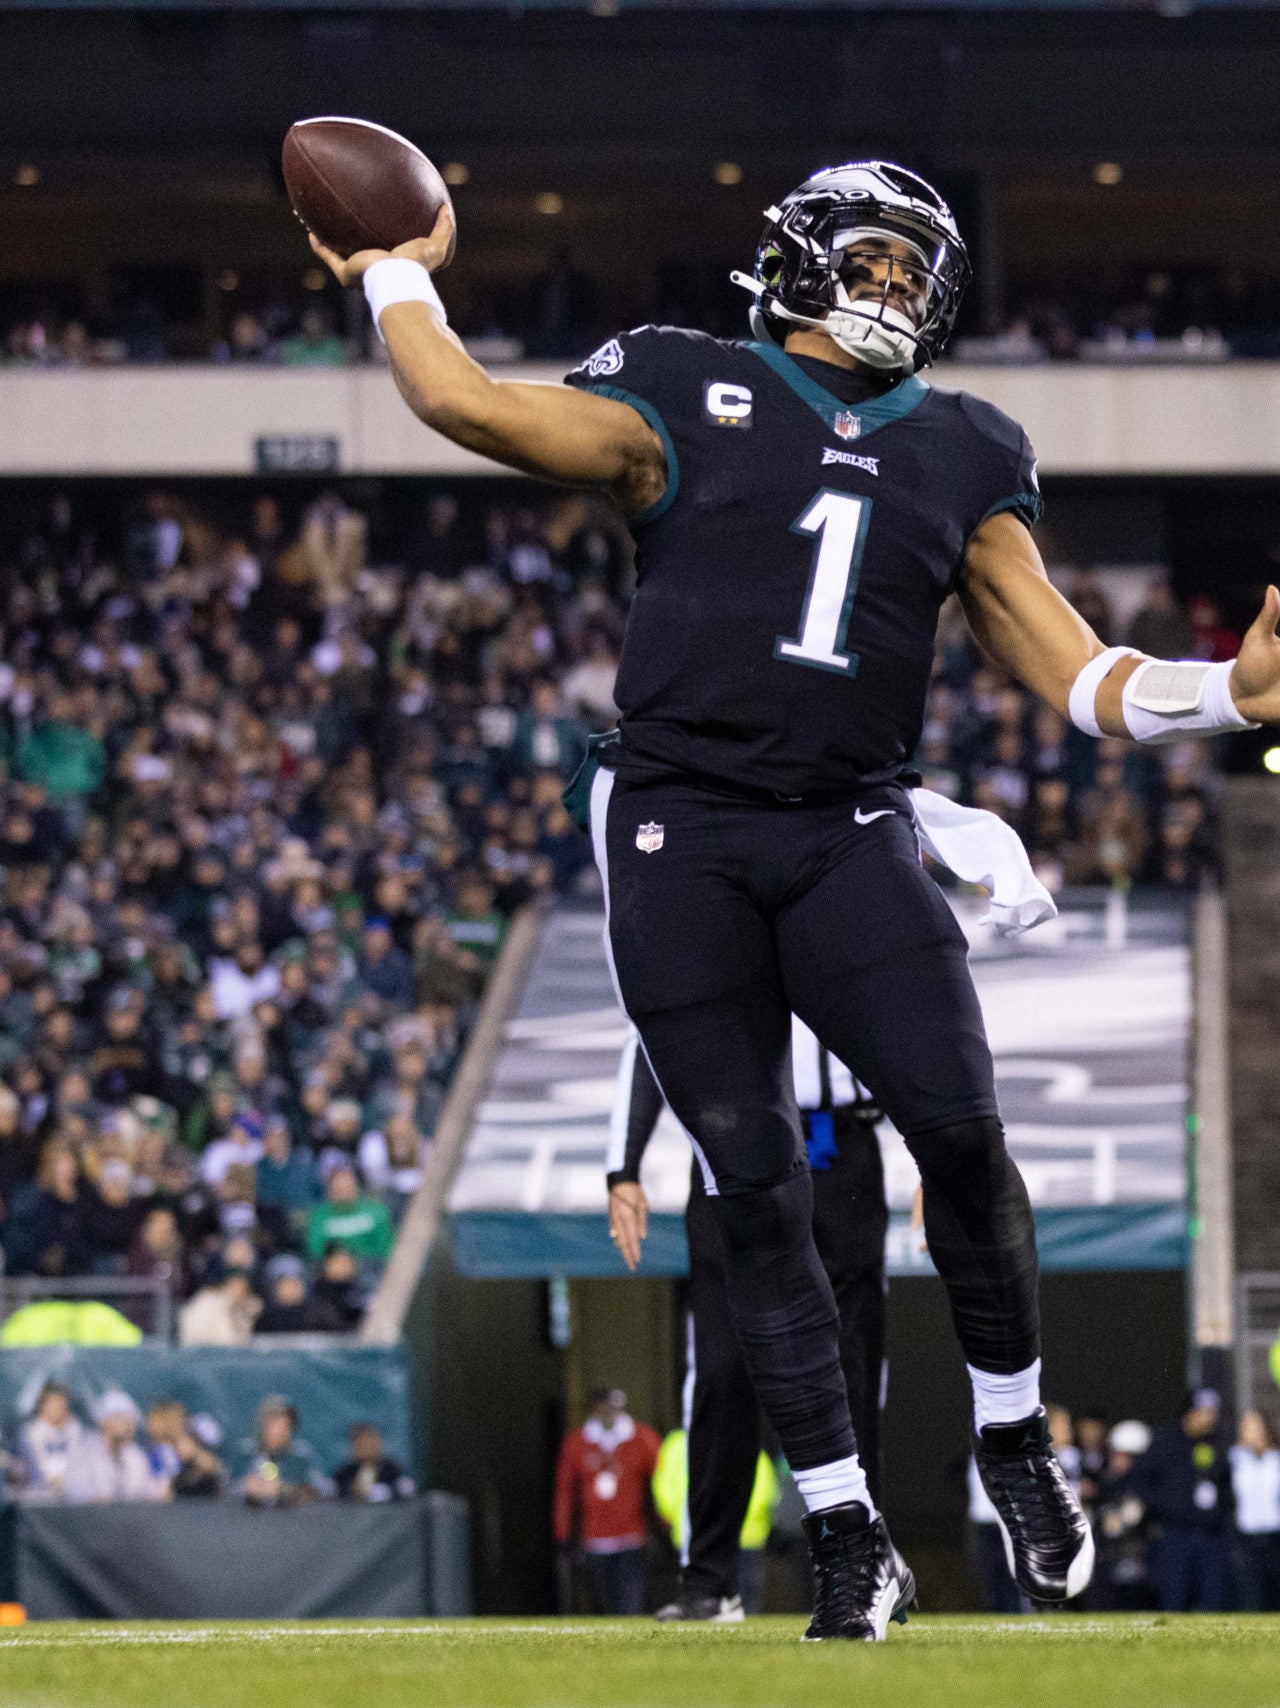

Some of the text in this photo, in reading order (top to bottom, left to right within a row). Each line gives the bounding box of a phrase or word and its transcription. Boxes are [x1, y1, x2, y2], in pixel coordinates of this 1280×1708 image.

[708, 383, 752, 417] C
[821, 447, 880, 477] EAGLES
[774, 487, 872, 678] 1
